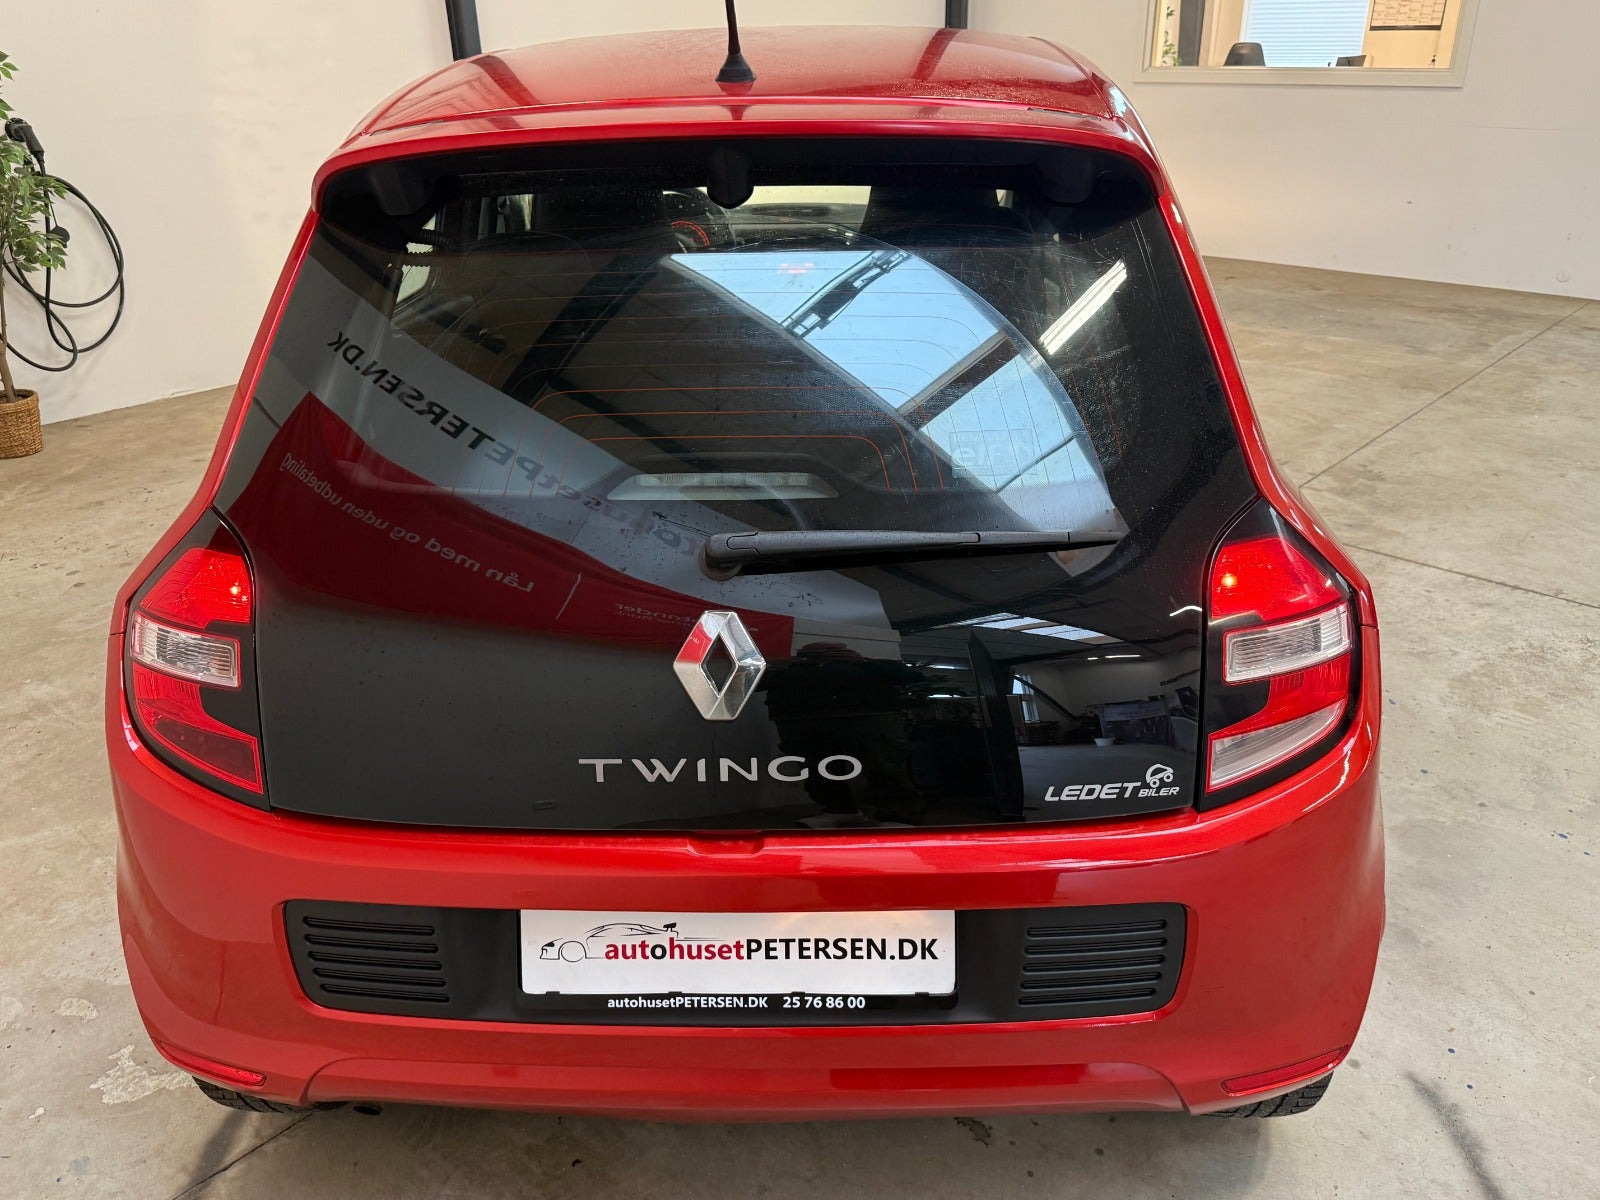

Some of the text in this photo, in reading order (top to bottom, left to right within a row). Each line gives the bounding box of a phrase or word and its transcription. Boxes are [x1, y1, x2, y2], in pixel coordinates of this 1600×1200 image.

[578, 754, 863, 783] TWINGO
[1044, 781, 1180, 802] LEDET BILER
[604, 937, 938, 961] autohusetPETERSEN.DK
[607, 996, 866, 1009] autohusetPETERSEN.DK 25 76 86 00
